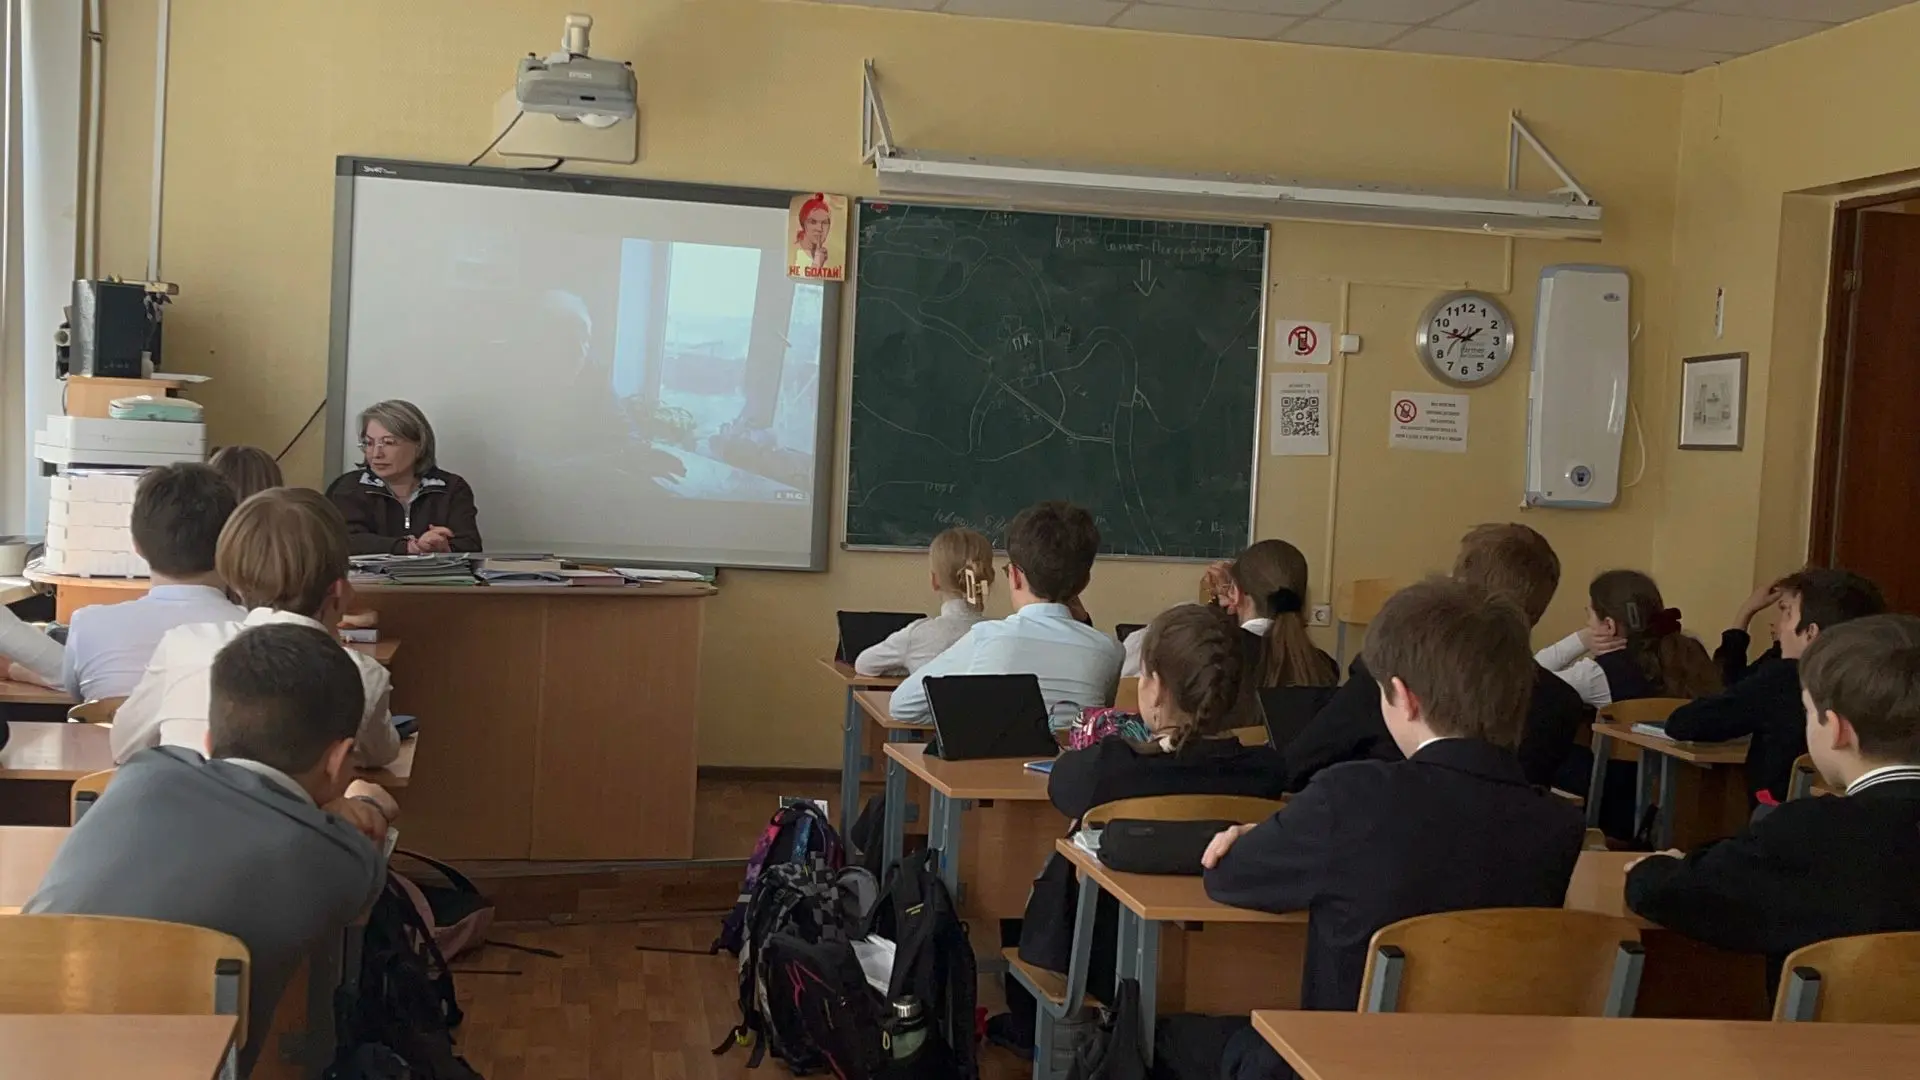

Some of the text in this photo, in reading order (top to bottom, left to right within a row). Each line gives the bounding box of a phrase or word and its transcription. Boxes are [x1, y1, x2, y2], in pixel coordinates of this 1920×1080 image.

[789, 265, 801, 276] НЕ
[1446, 307, 1460, 316] 11
[1461, 303, 1476, 313] 12
[1481, 308, 1487, 318] 1
[1435, 319, 1450, 328] 10
[1490, 320, 1498, 330] 2
[1432, 334, 1440, 344] 9
[1493, 336, 1500, 346] 3
[1436, 349, 1444, 359] 8
[1487, 351, 1496, 360] 4
[1447, 361, 1454, 371] 7
[1461, 366, 1469, 375] 6
[1476, 362, 1485, 372] 5
